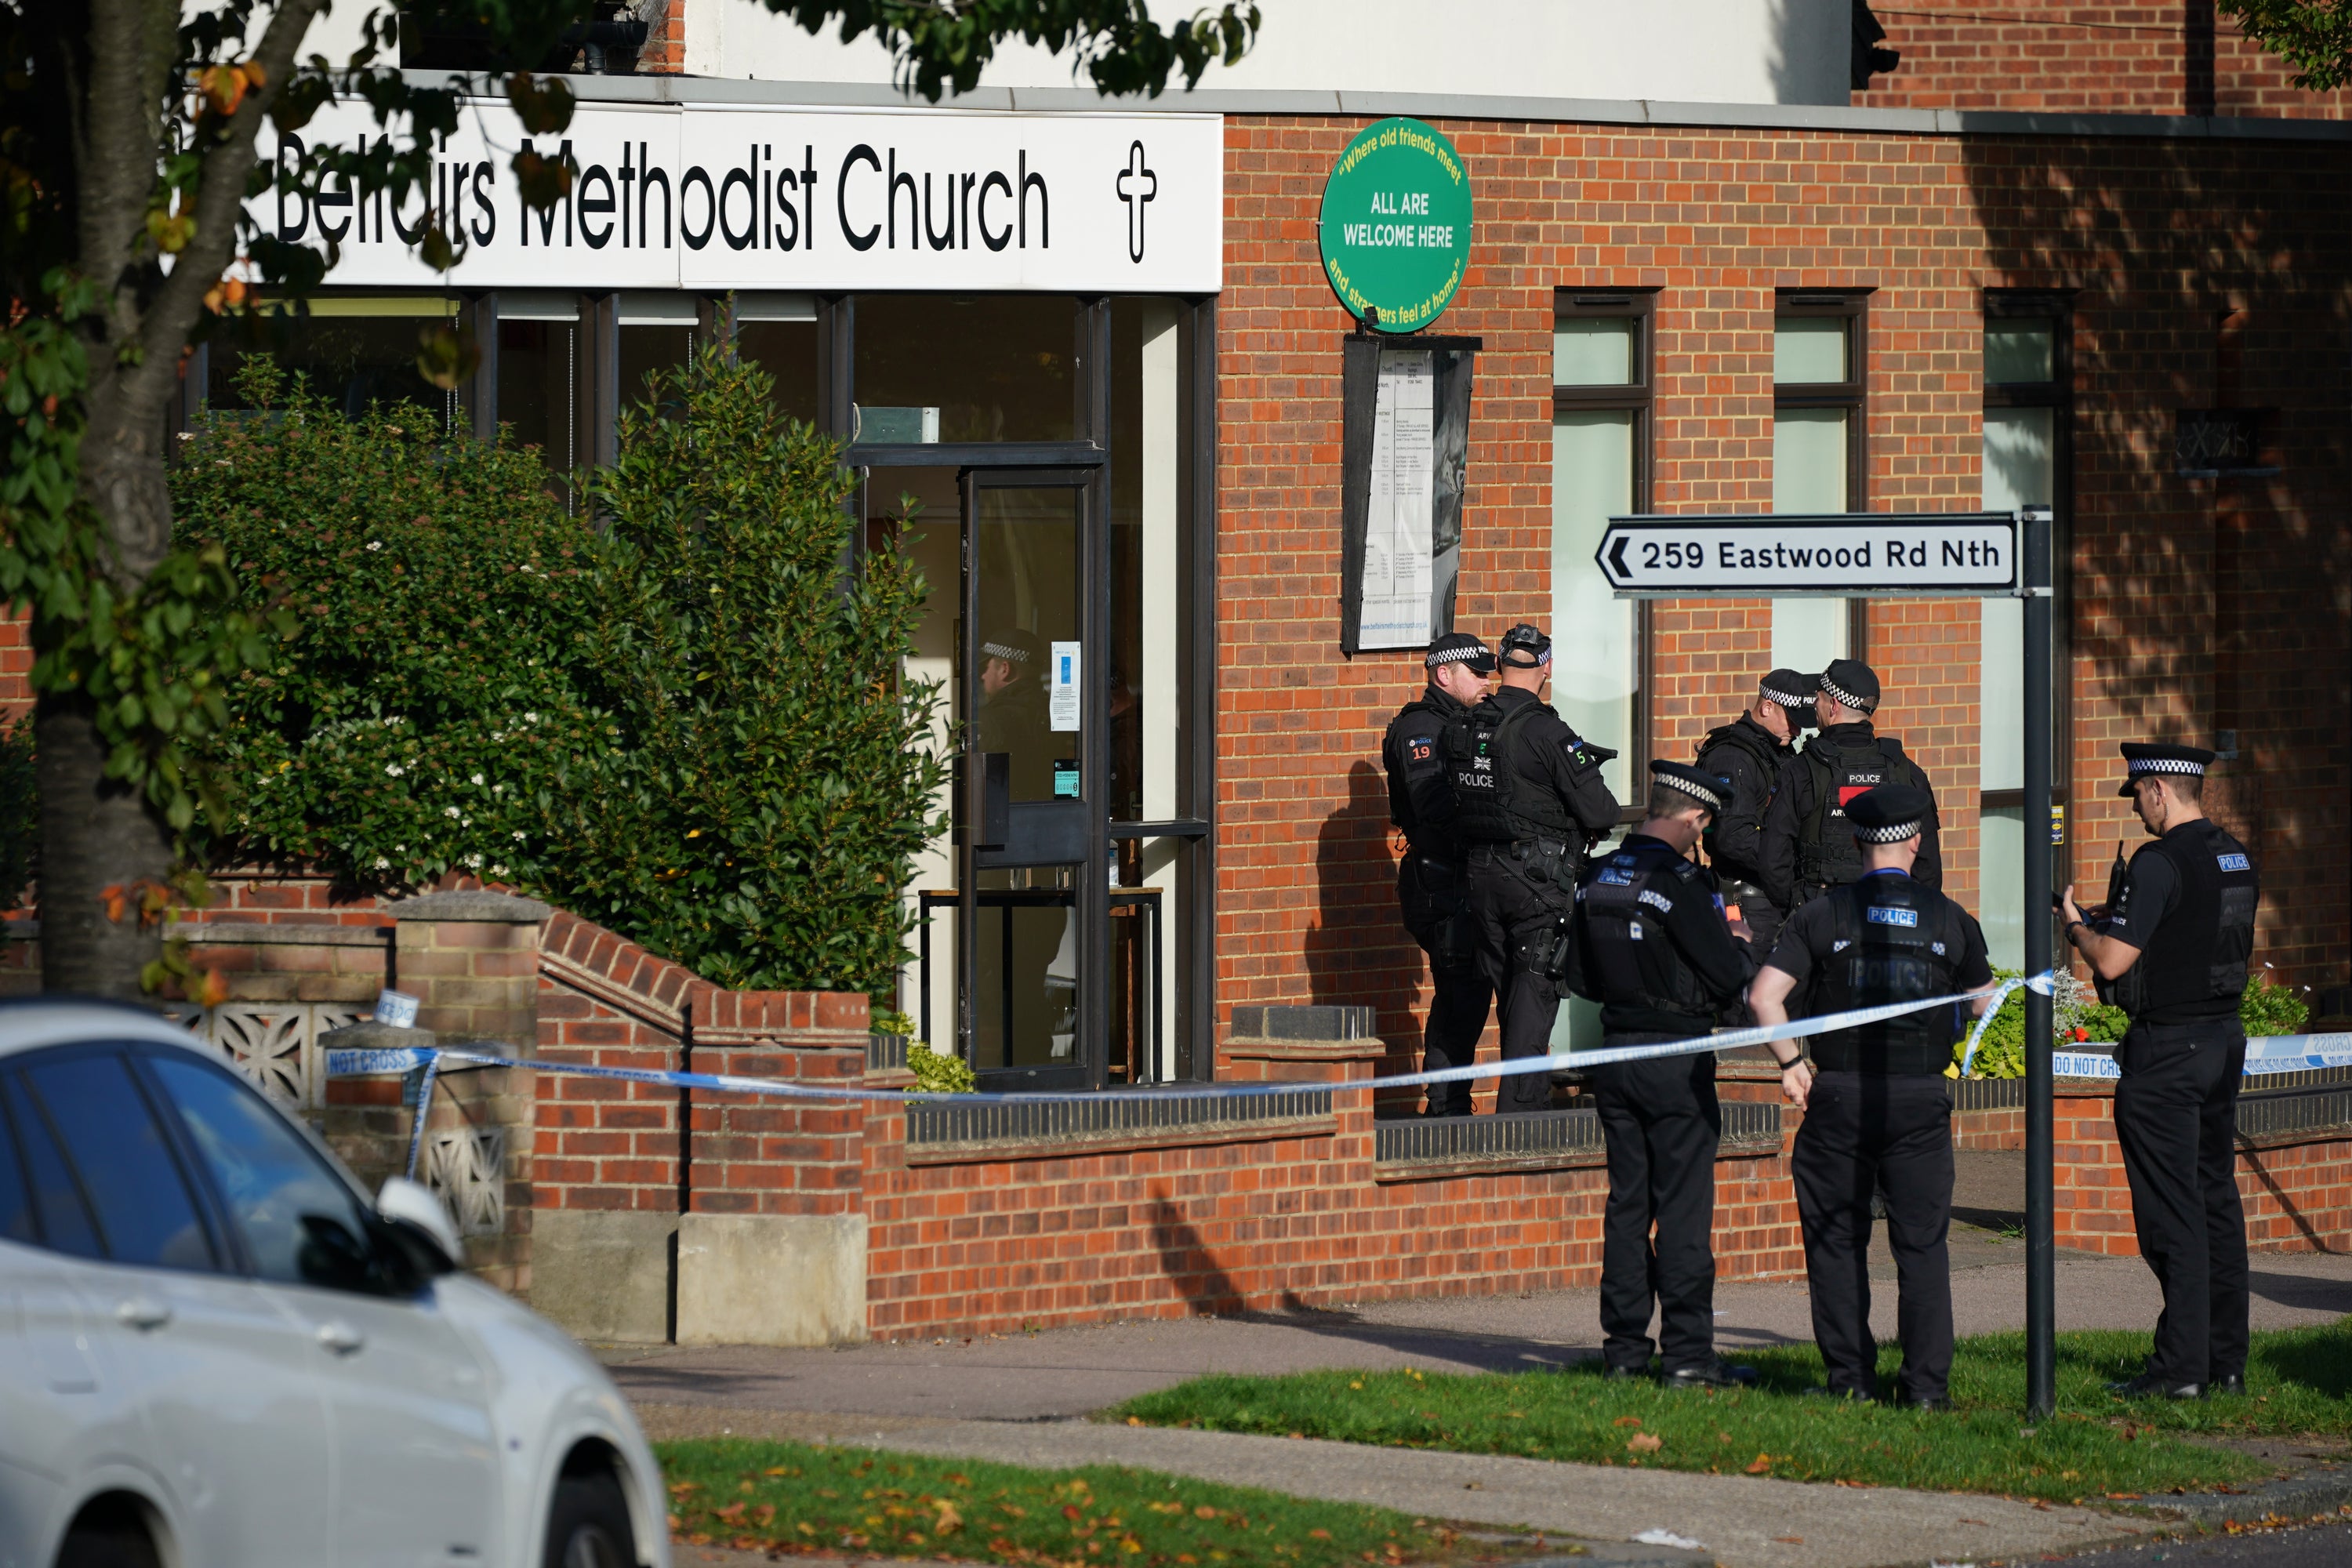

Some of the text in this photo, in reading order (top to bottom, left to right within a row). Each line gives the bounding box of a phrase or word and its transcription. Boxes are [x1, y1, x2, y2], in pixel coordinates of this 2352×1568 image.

[1380, 127, 1396, 147] old
[1399, 127, 1436, 155] friends
[1436, 147, 1461, 186] meet
[521, 138, 817, 252] Methodist
[837, 143, 1049, 252] Church
[1370, 191, 1429, 216] ALL ARE
[1344, 223, 1454, 248] WELCOME HERE
[1330, 257, 1349, 292] and
[1399, 303, 1418, 324] feel
[1421, 299, 1431, 318] at
[1642, 539, 1999, 568] 259 Eastwood Rd Nth
[1412, 746, 1430, 760] 19
[1576, 750, 1586, 764] 5
[1458, 771, 1494, 788] POLICE
[1849, 774, 1881, 783] POLICE
[2220, 855, 2248, 869] POLICE
[1871, 909, 1915, 925] POLICE
[329, 1052, 355, 1073] NOT
[360, 1050, 408, 1072] CROSS
[2054, 1056, 2070, 1074] DO
[2074, 1057, 2096, 1076] NOT
